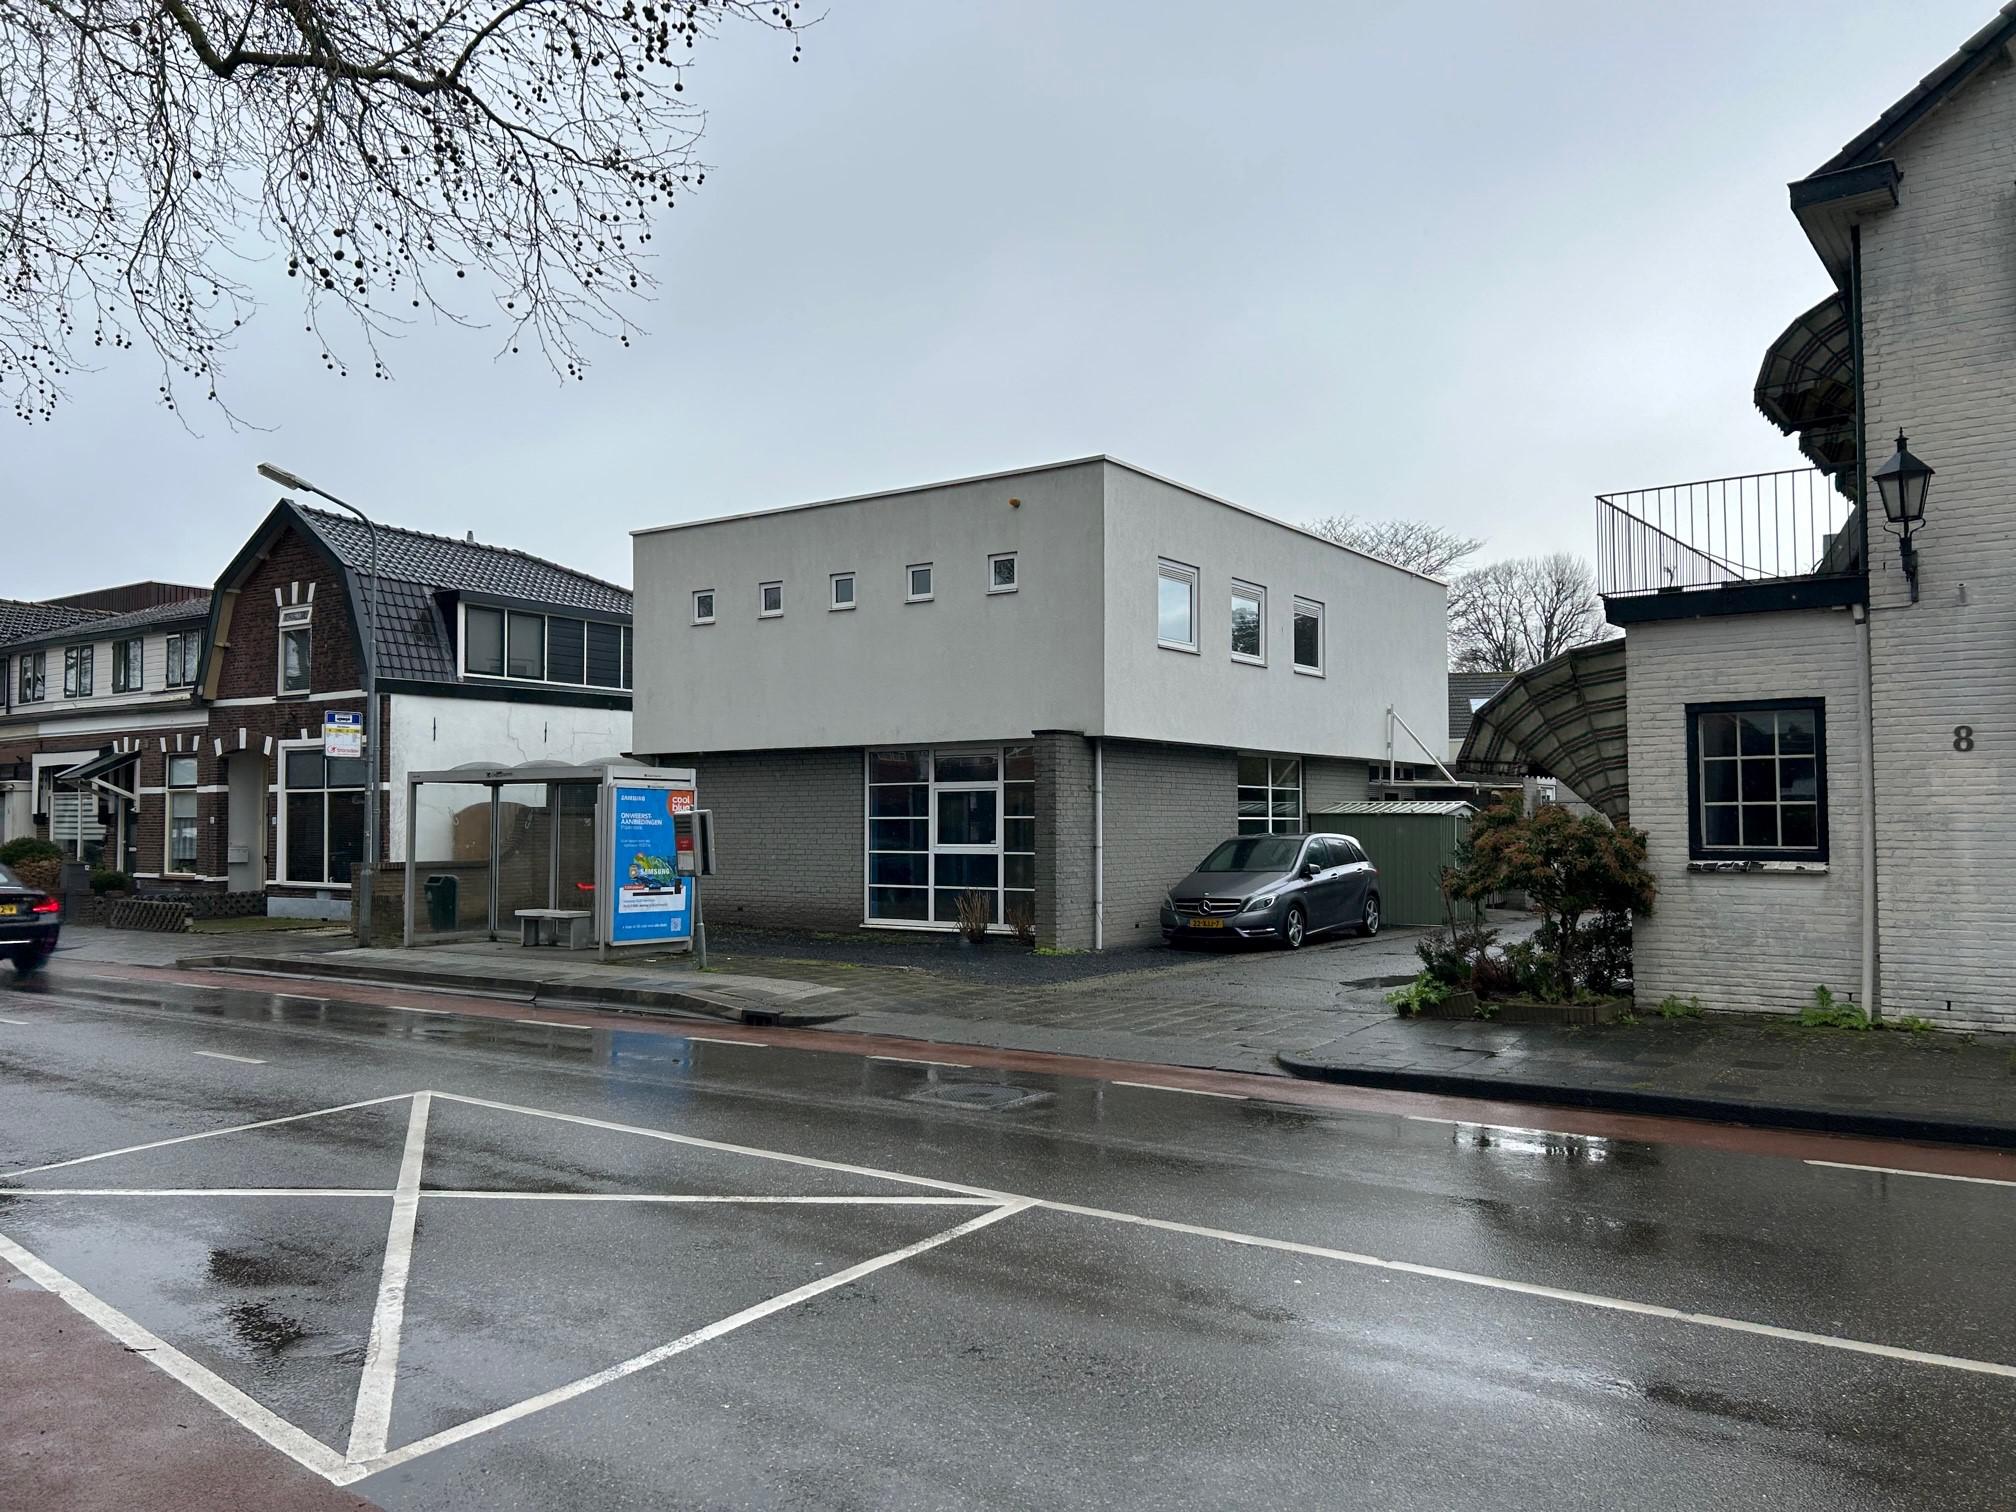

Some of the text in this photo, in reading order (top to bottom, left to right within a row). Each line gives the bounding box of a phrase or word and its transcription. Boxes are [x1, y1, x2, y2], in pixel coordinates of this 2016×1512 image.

[1953, 725, 1974, 752] 8
[672, 796, 690, 804] cool
[672, 803, 690, 812] blue
[640, 868, 670, 876] SAMSUNG
